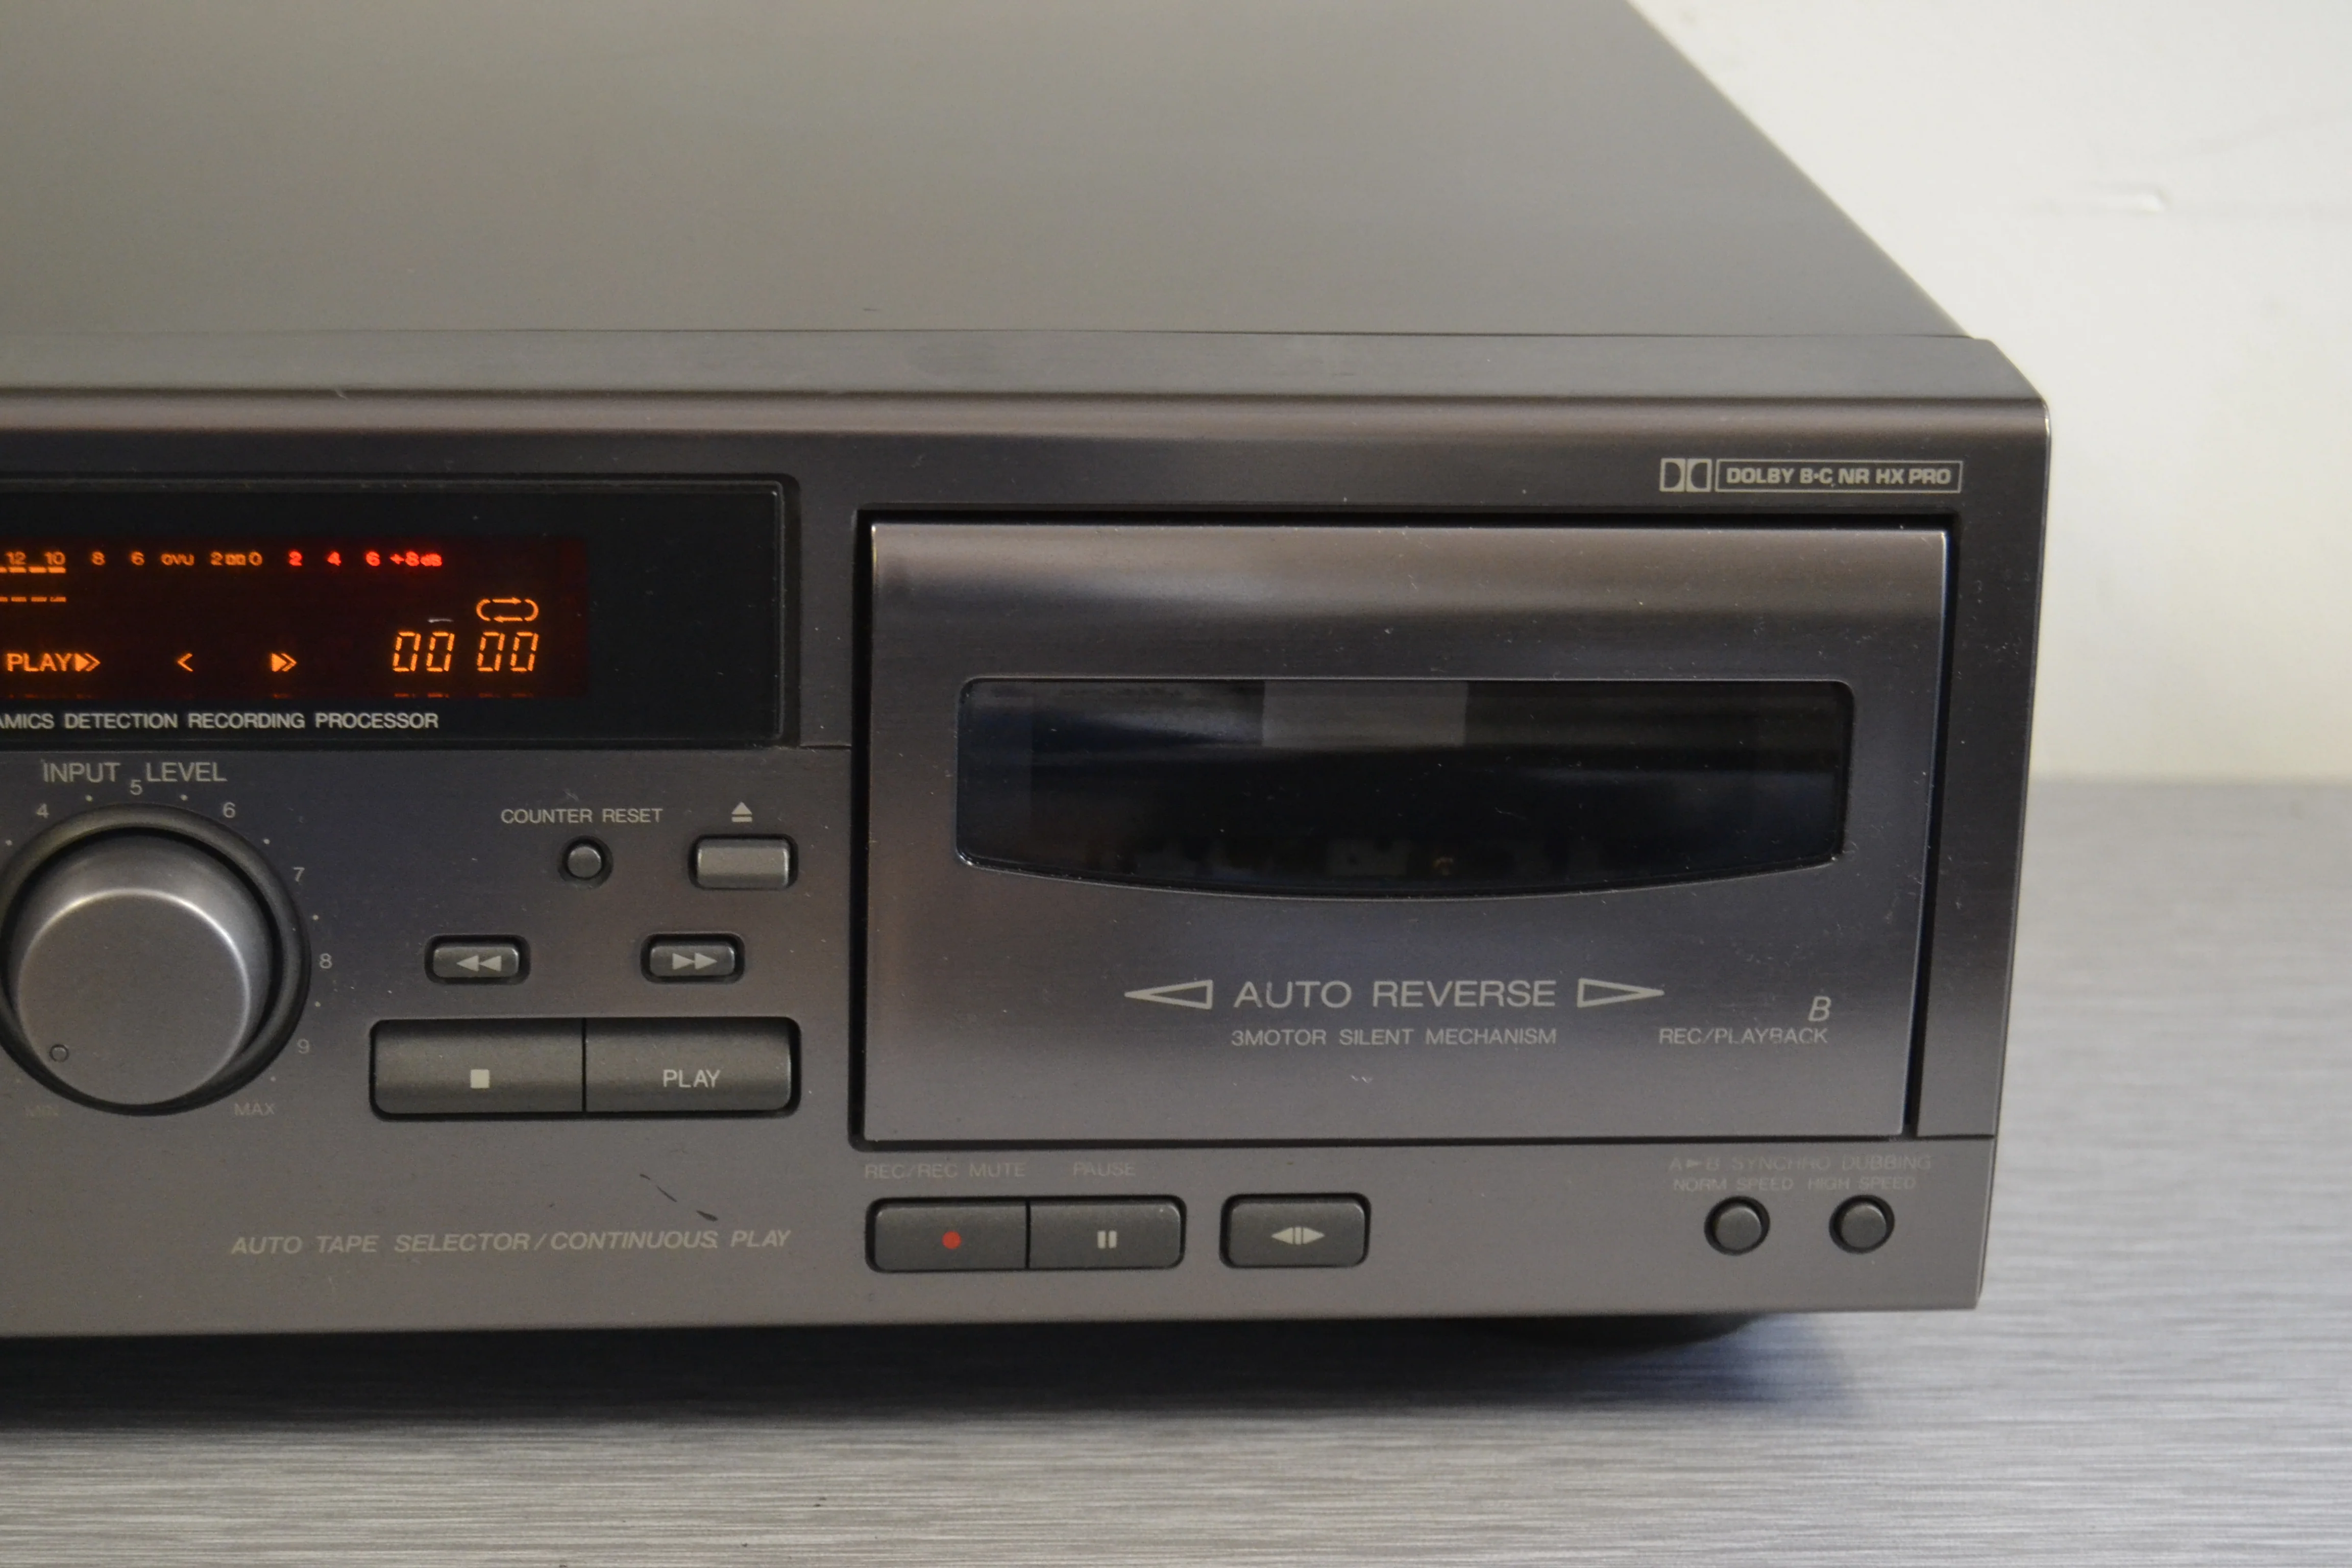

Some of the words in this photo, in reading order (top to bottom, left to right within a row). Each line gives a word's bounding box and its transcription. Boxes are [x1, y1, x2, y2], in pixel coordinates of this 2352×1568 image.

[1726, 467, 1795, 484] DOLBY
[1839, 467, 1870, 484] NR
[1876, 467, 1904, 484] HX
[1908, 467, 1952, 484] PRO
[5, 551, 26, 565] 12
[44, 551, 66, 565] 10
[91, 551, 106, 566] 8
[131, 551, 145, 566] 6
[288, 551, 303, 567] 2
[327, 551, 341, 566] 4
[365, 551, 381, 567] 6
[6, 653, 72, 672] PLAY
[64, 713, 178, 729] DETECTION
[188, 713, 306, 729] RECORDING
[315, 713, 439, 729] PROCESSOR
[41, 762, 121, 782] INPUT
[146, 762, 228, 782] LEVEL
[130, 780, 143, 796] 5
[36, 803, 50, 818] 4
[223, 802, 236, 818] 6
[500, 808, 592, 824] COUNTER
[602, 808, 663, 823] RESET
[293, 866, 305, 883] 7
[318, 952, 333, 969] 8
[1234, 981, 1353, 1008] AUTO
[1372, 980, 1557, 1007] REVERSE
[1807, 995, 1832, 1022] B
[1231, 1029, 1327, 1046] 3MOTOR
[1338, 1028, 1415, 1046] SILENT
[1426, 1028, 1557, 1045] MECHANISM
[1659, 1027, 1828, 1045] REC/PLAYBACK
[297, 1038, 310, 1055] 9
[662, 1069, 721, 1088] PLAY
[234, 1102, 276, 1117] MAX
[864, 1162, 958, 1181] REC/REC
[968, 1161, 1027, 1179] MUTE
[1072, 1160, 1136, 1178] PAUSE
[1731, 1156, 1831, 1171] SYNCHRO
[1841, 1155, 1932, 1170] DUBBING
[1673, 1178, 1727, 1192] NORM
[1735, 1177, 1795, 1191] SPEED
[1807, 1177, 1850, 1191] HIGH
[1858, 1176, 1917, 1190] SPEED
[231, 1235, 303, 1255] AUTO
[316, 1234, 381, 1254] TAPE
[394, 1230, 718, 1253] SELECTOR/CONTINUOUS
[730, 1230, 792, 1248] PLAY
